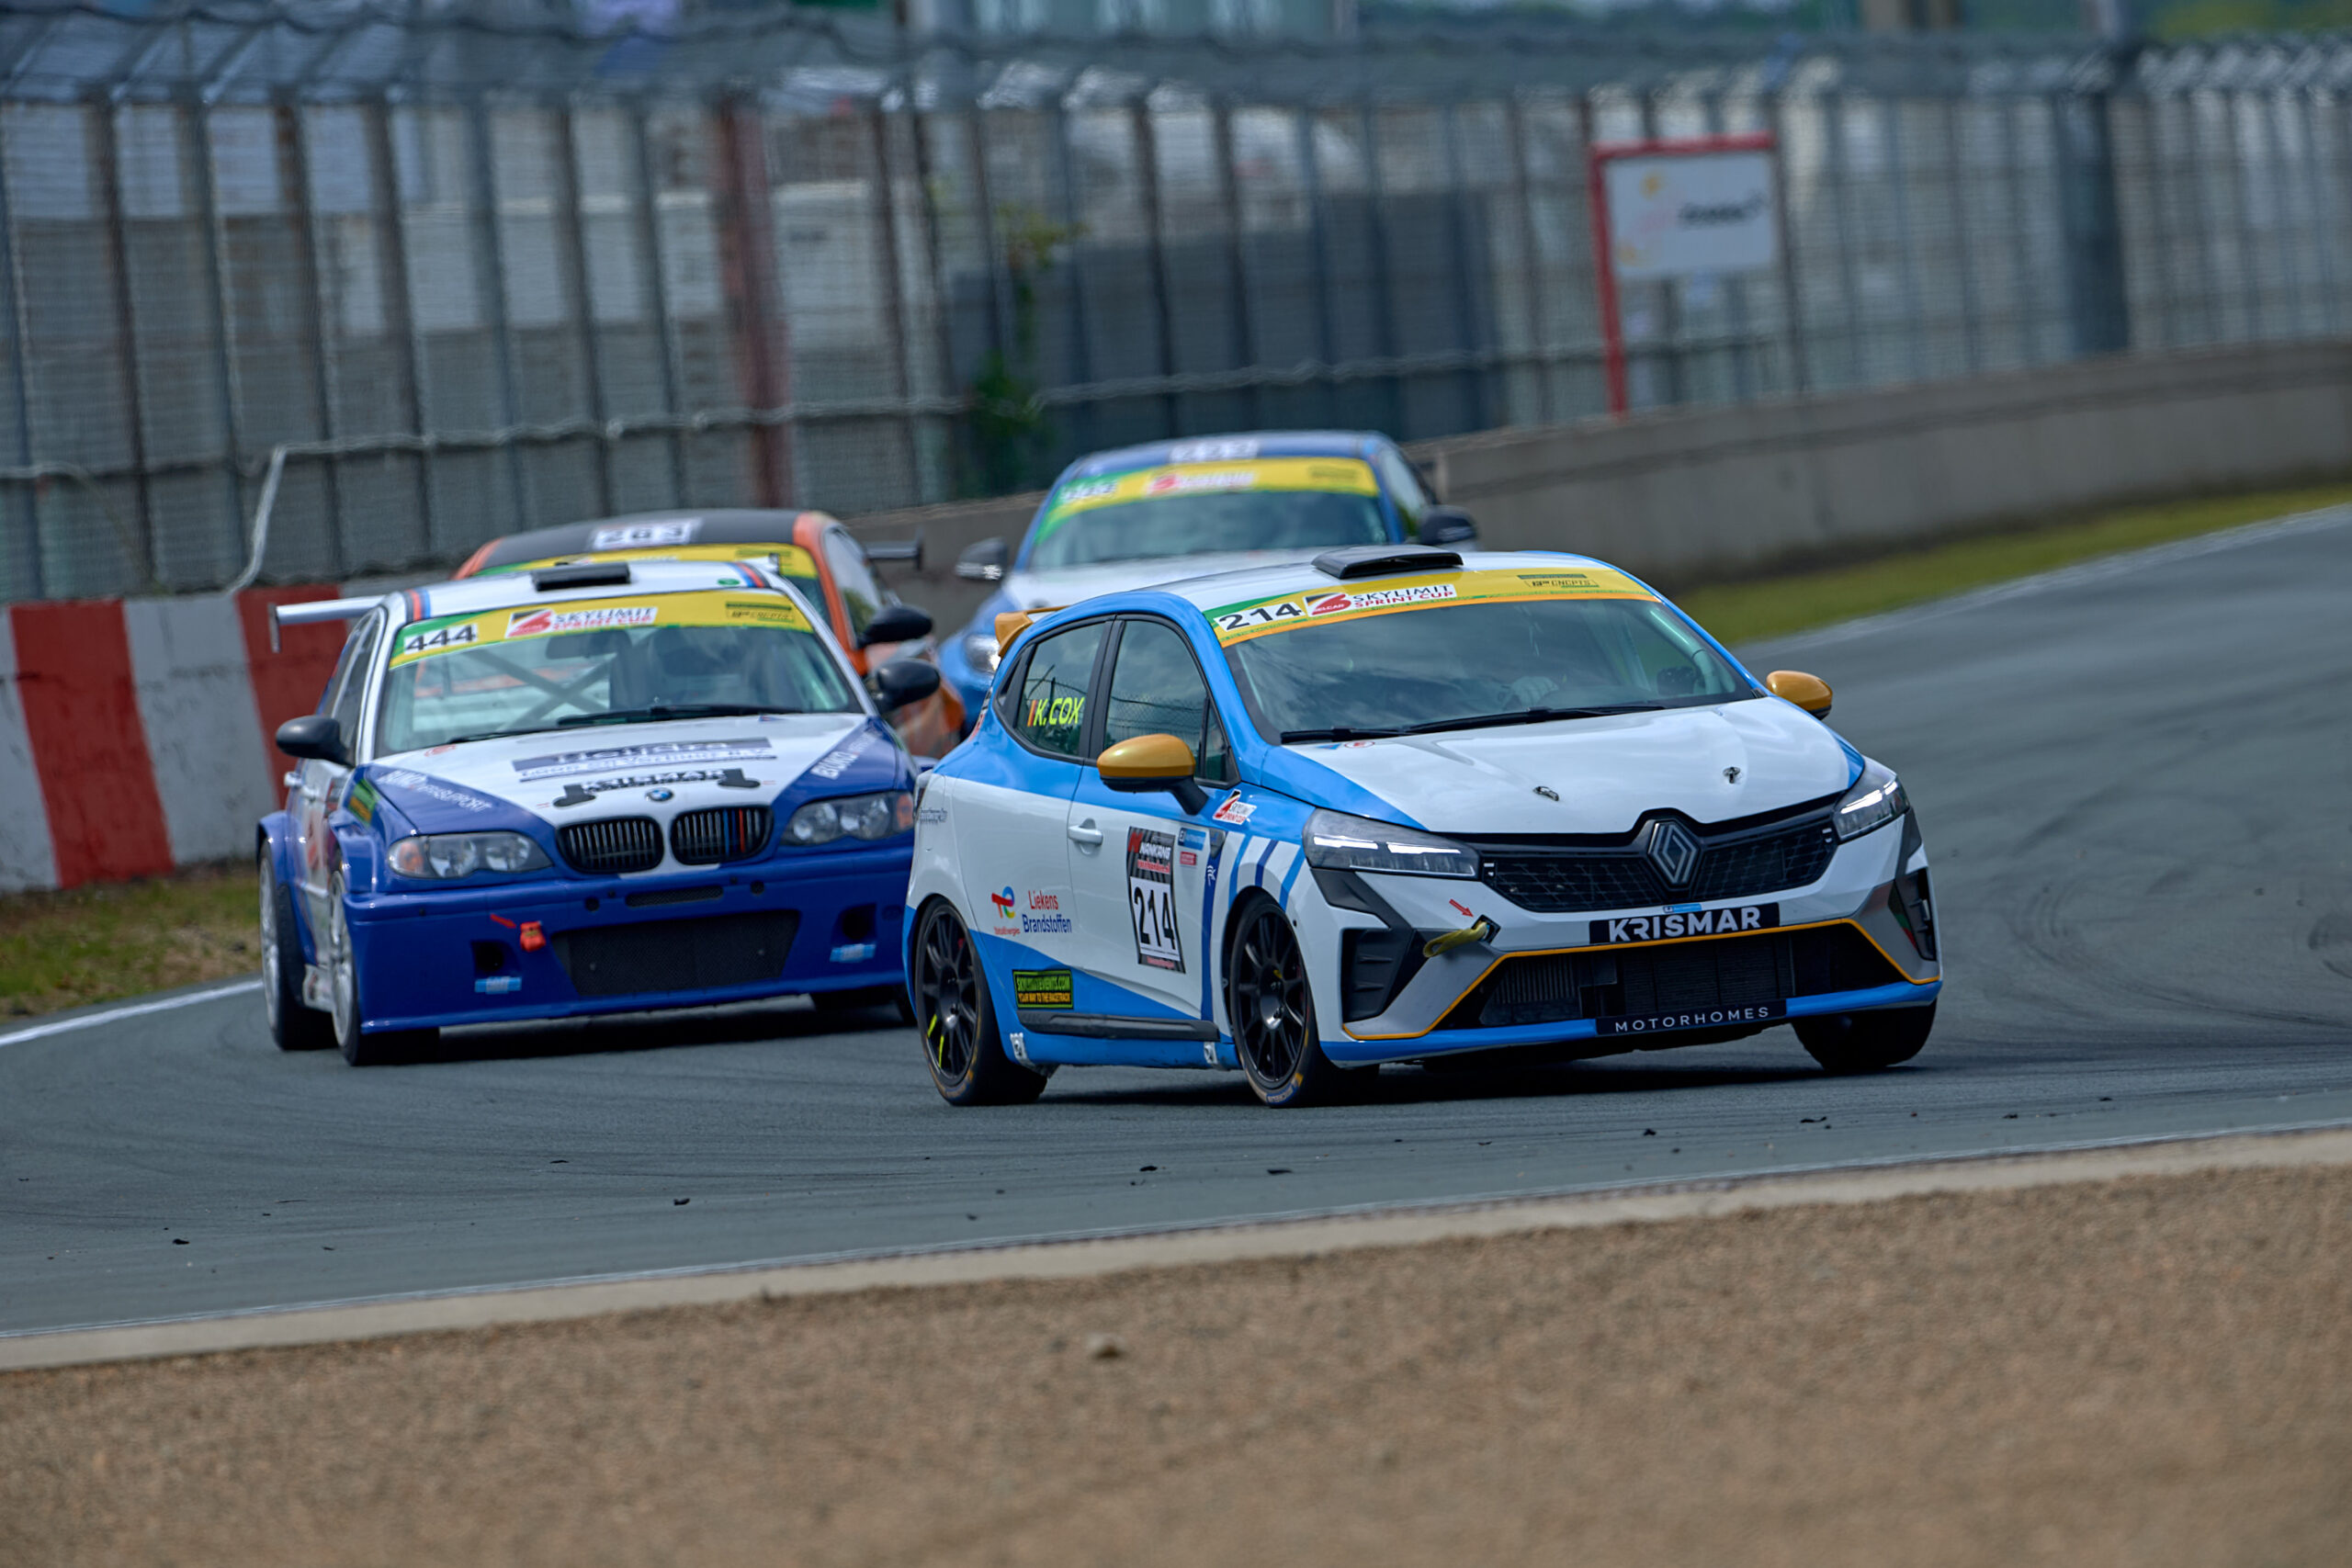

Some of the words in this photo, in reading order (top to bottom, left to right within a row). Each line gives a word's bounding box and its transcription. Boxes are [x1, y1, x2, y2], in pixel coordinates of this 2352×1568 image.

[1352, 585, 1451, 603] SKYLIMIT
[1354, 595, 1411, 609] SPRINT
[1416, 591, 1453, 602] CUP
[556, 607, 655, 623] SKYLIMIT
[1218, 603, 1303, 631] 214
[406, 625, 477, 651] 444
[1139, 841, 1171, 860] NANKANG
[1028, 889, 1059, 910] Liekens
[1022, 913, 1073, 933] Brandstoffen
[1134, 886, 1176, 950] 214
[1609, 906, 1761, 942] KRISMAR
[1614, 1007, 1770, 1032] MOTORHOMES
